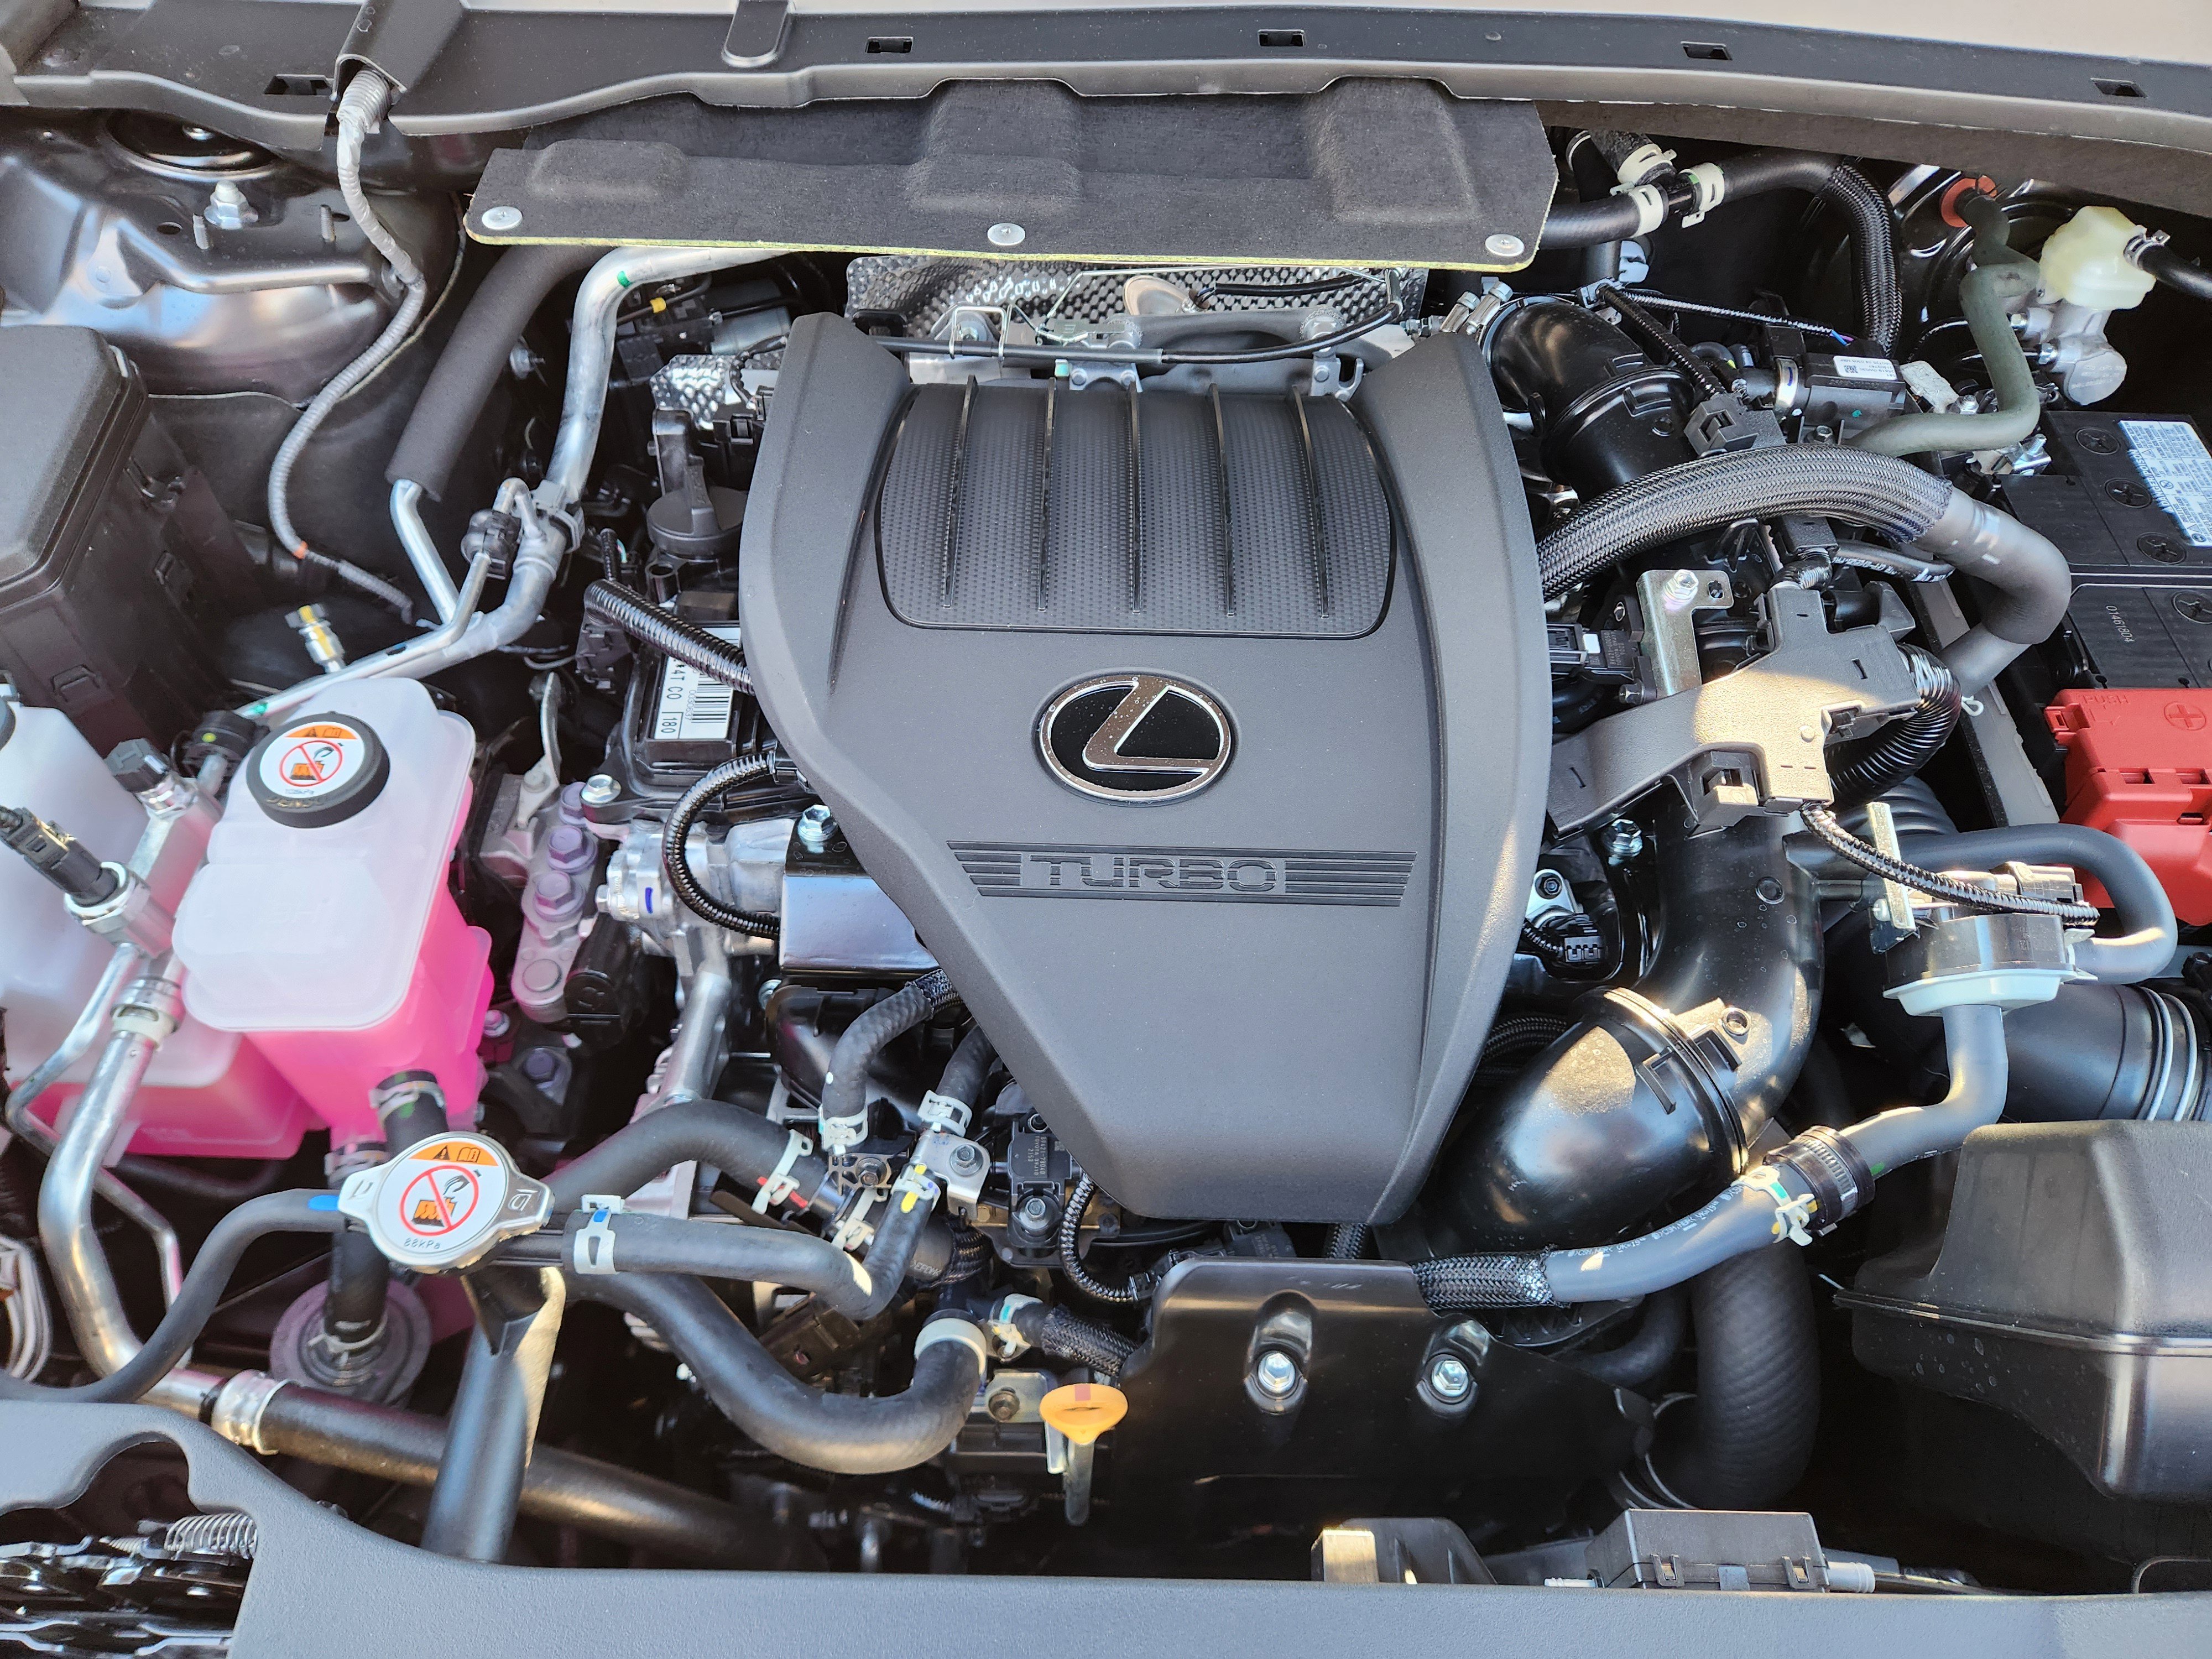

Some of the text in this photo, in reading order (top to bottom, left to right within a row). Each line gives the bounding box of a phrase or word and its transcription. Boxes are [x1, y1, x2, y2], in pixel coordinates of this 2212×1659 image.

[2106, 605, 2135, 643] 01461804
[2083, 695, 2128, 704] PUSH
[660, 717, 678, 733] 180
[1029, 853, 1279, 893] TURBO
